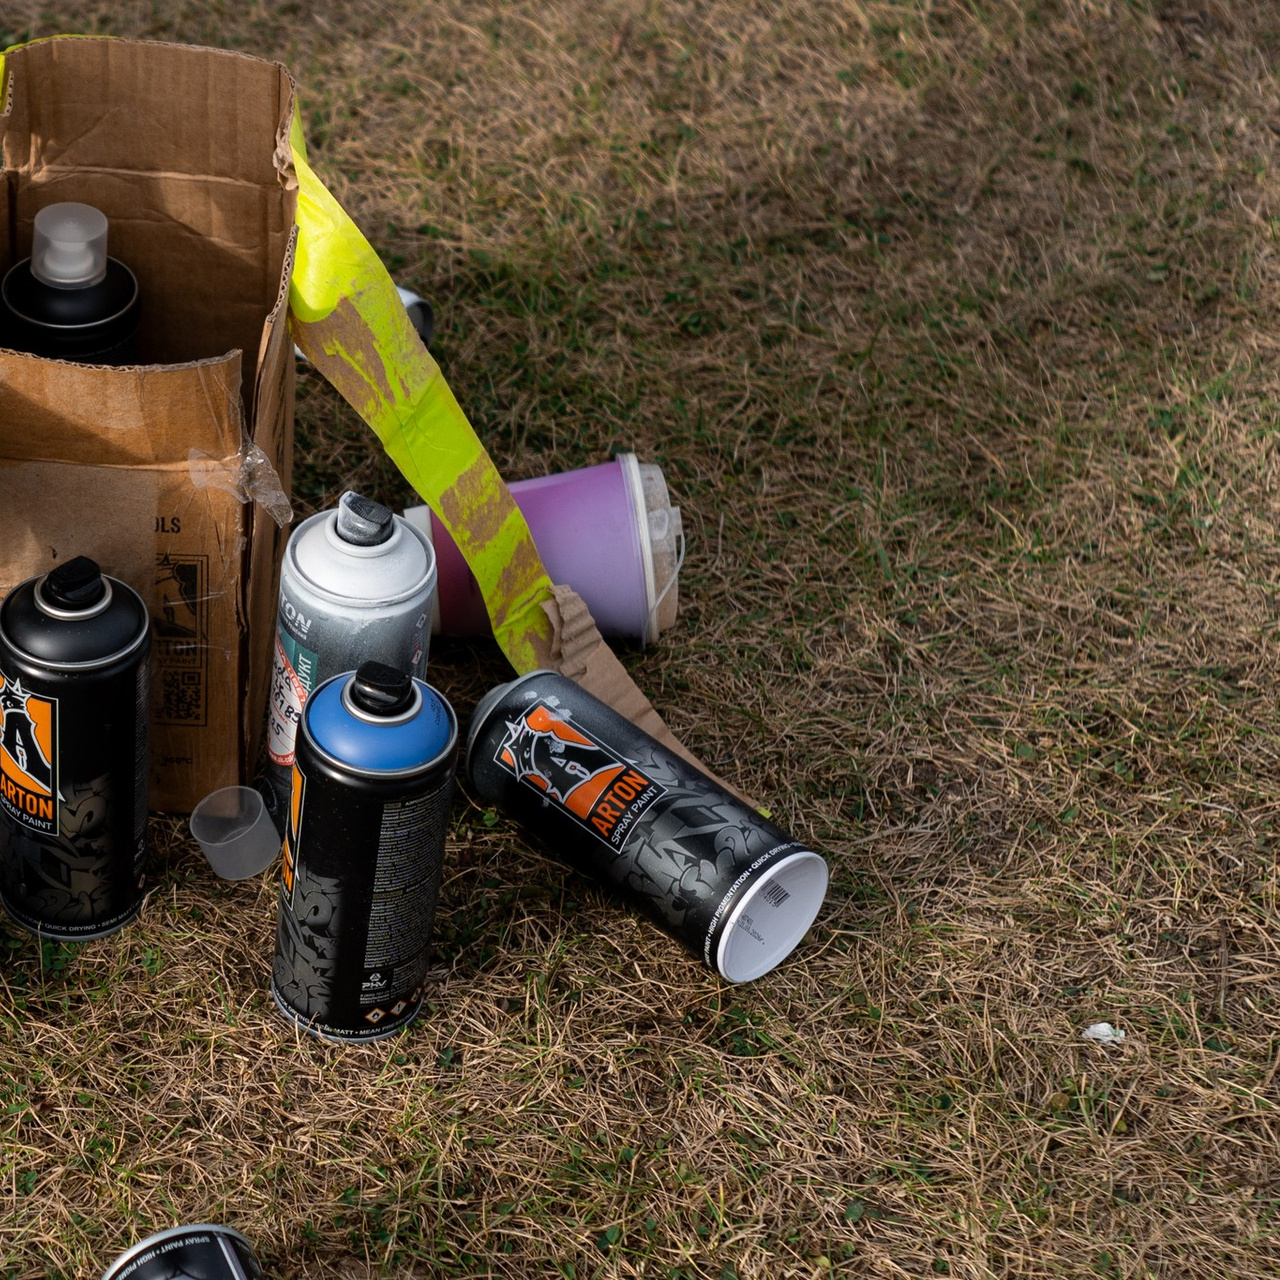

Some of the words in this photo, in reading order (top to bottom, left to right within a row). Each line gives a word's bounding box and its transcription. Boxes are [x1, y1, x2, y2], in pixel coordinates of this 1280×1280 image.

[0, 773, 54, 821] ARTON
[591, 768, 649, 837] ARTON
[0, 793, 22, 818] SPRAY
[23, 813, 53, 830] PAINT
[612, 810, 633, 845] SPRAY
[630, 785, 657, 813] PAINT
[708, 917, 719, 934] HIGH
[715, 870, 750, 918] PIGMENTATION
[750, 853, 771, 869] QUICK
[44, 923, 67, 931] QUICK
[69, 924, 96, 932] DRYING
[101, 917, 117, 927] SEMI
[359, 1027, 380, 1035] MEAN
[161, 1239, 183, 1252] PAINT
[185, 1236, 210, 1245] SPRAY
[136, 1250, 155, 1266] HIGH
